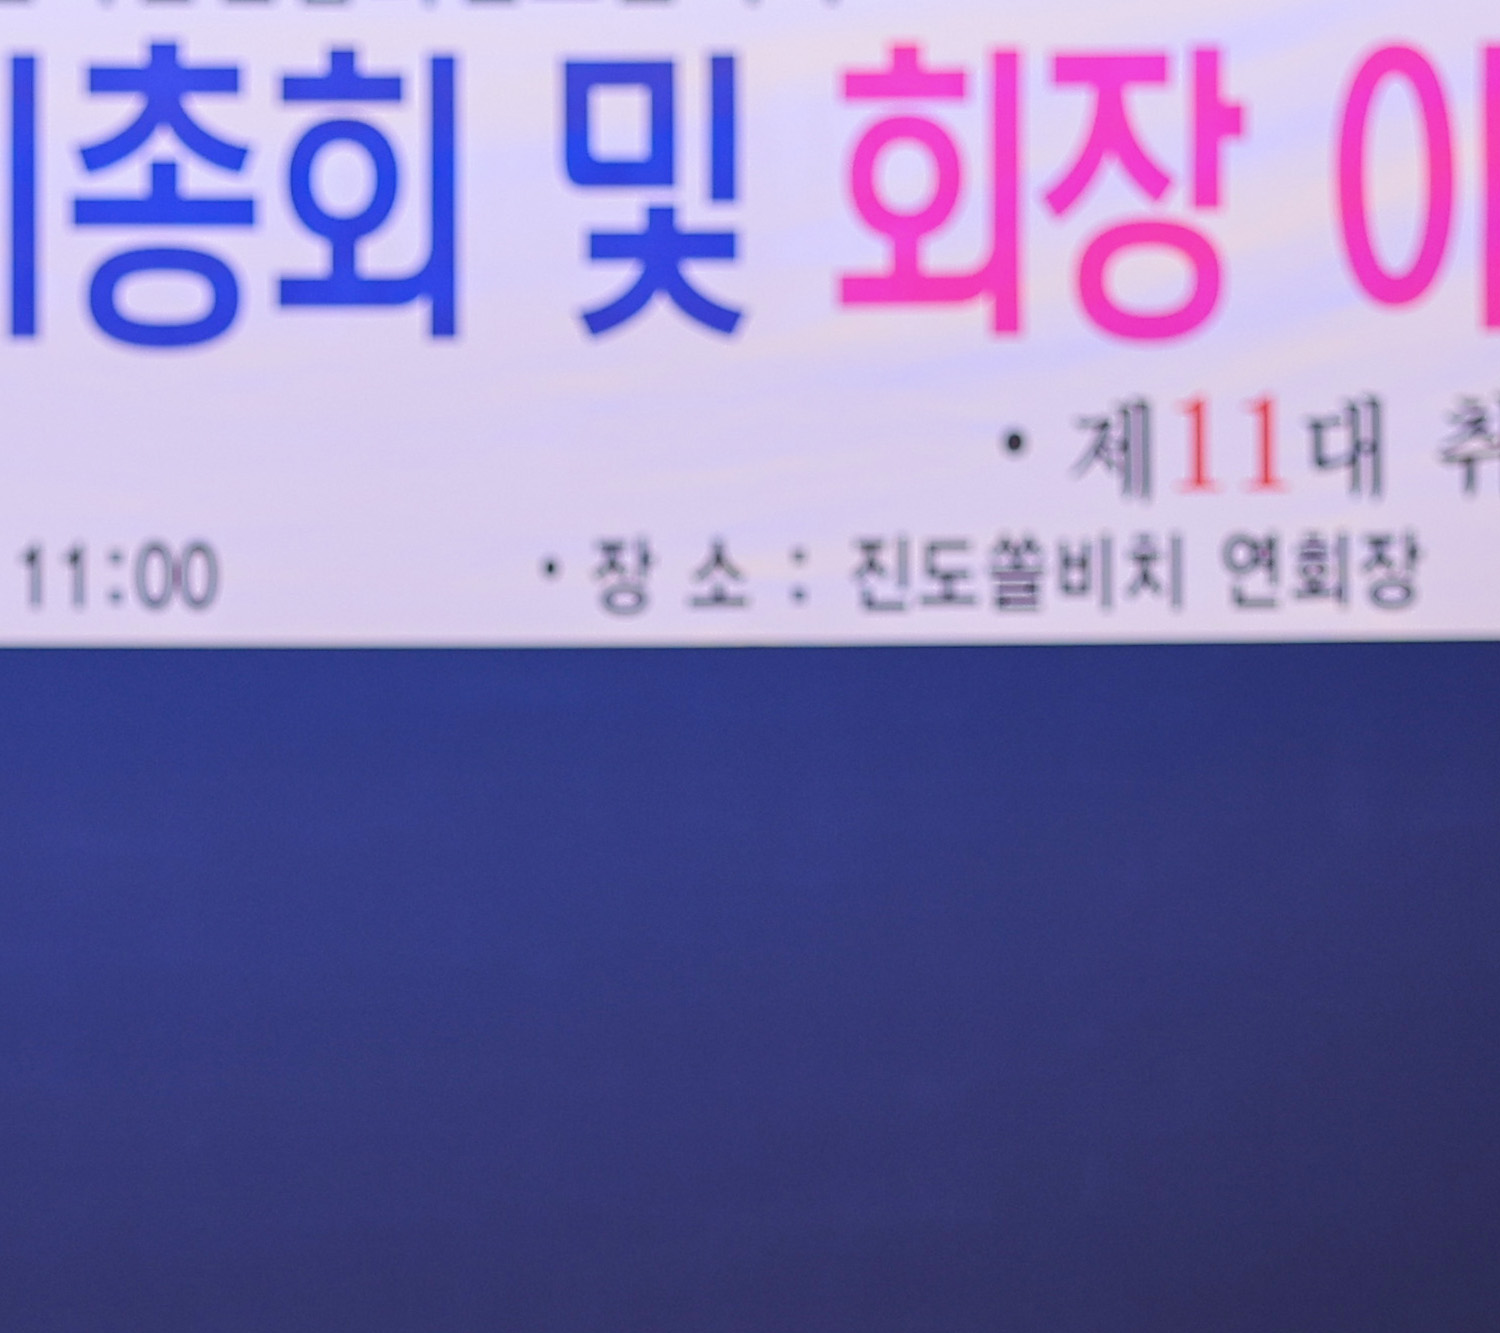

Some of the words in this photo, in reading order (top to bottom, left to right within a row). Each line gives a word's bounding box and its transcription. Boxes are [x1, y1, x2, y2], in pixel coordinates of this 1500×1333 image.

[559, 52, 747, 340] 및
[837, 43, 1247, 344] 회장
[1072, 392, 1386, 499] 제11대
[20, 540, 222, 611] 11:00
[850, 533, 1186, 613] 진도쏠비치
[1218, 532, 1422, 612] 연회장
